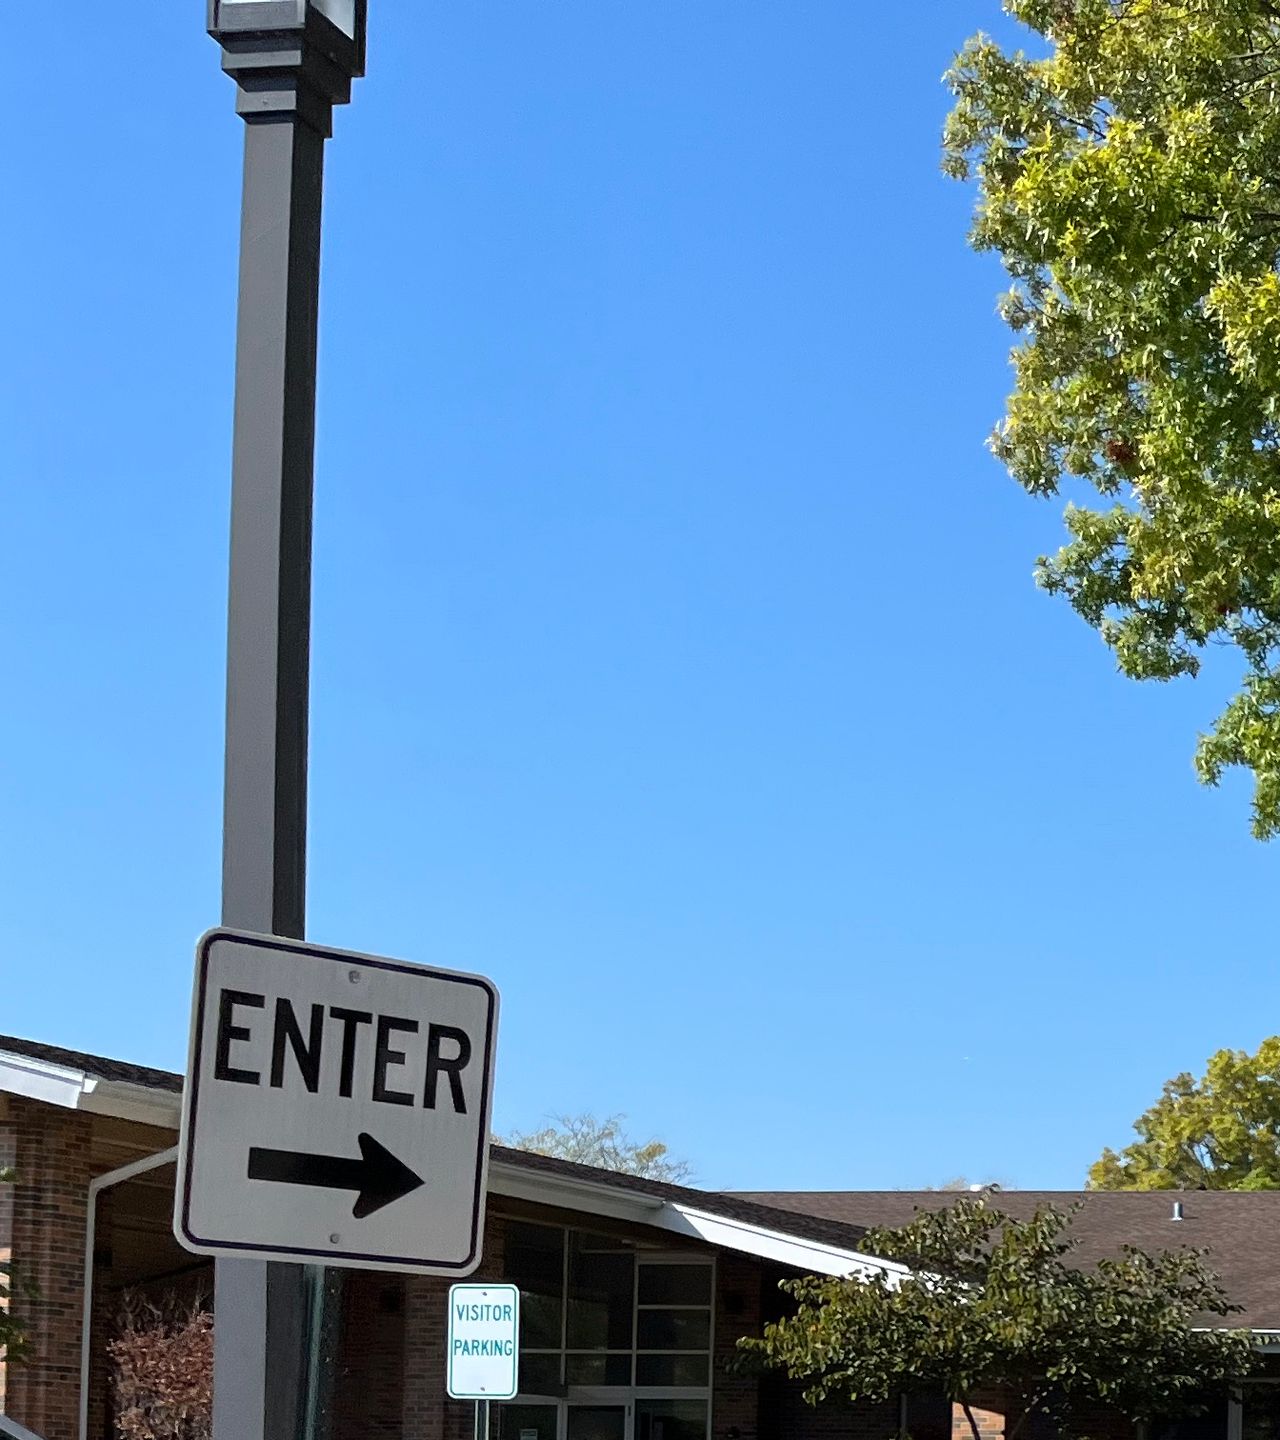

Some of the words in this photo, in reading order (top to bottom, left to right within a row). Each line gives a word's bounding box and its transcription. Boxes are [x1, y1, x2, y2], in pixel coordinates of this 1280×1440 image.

[214, 988, 472, 1114] ENTER
[456, 1304, 512, 1321] VISITOR
[453, 1339, 513, 1356] PARKING
